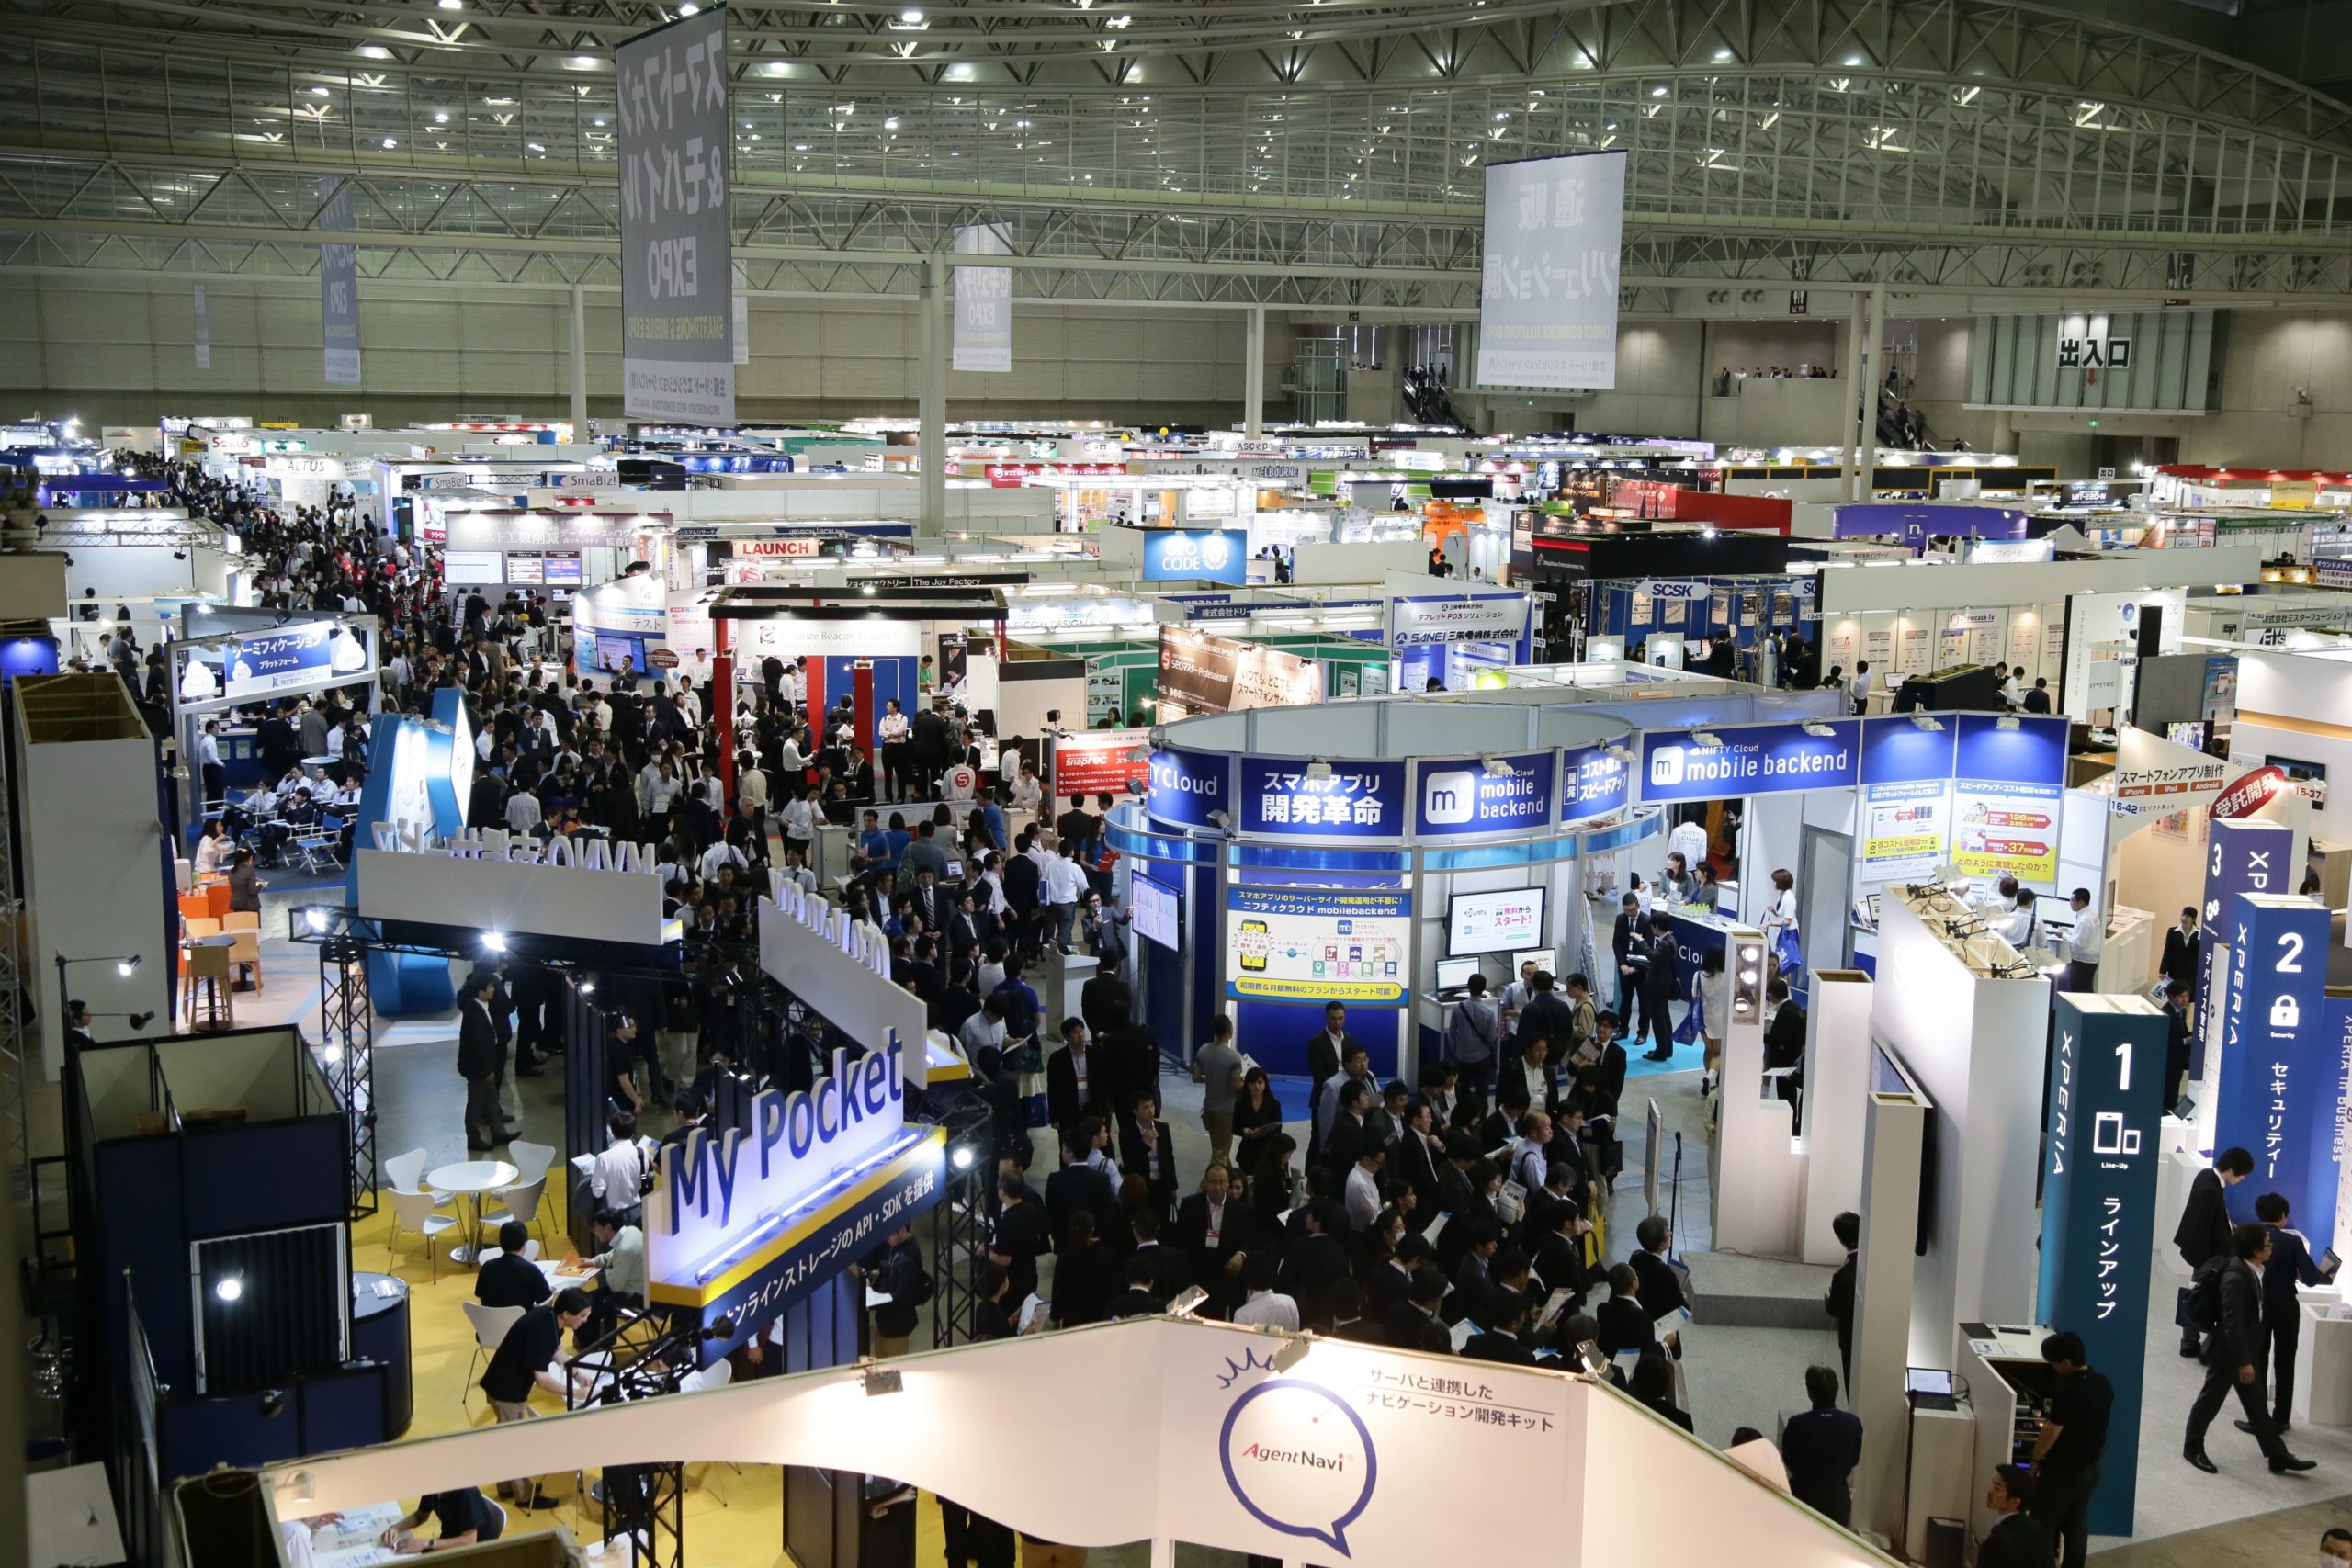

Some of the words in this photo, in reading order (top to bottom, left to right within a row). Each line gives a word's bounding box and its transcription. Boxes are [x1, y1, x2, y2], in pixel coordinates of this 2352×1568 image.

[2059, 338, 2130, 367] 出入口
[288, 460, 325, 472] ALTUS
[1251, 465, 1299, 478] MELBOURNE
[435, 477, 464, 489] SmaBiz!
[571, 476, 616, 487] SmaBiz!
[470, 529, 560, 546] テスト工数削減
[742, 543, 809, 555] LAUNCH
[1162, 558, 1200, 571] CODE
[2316, 559, 2352, 570] オウンドメディ
[914, 578, 930, 586] The
[933, 578, 947, 588] Joy
[949, 578, 981, 588] Factory
[1652, 583, 1693, 597] SCSK
[1418, 614, 1446, 622] タブレット
[1447, 612, 1463, 620] POS
[1464, 611, 1504, 620] ソリューション
[820, 631, 855, 641] Beacon
[1410, 631, 1446, 643] SANEI
[1447, 628, 1519, 642] 三栄電機株式会社
[259, 656, 299, 670] プラットフォーム
[1702, 745, 1731, 756] NIFTY
[1733, 742, 1759, 753] Cloud
[1065, 755, 1108, 768] snaprec
[1687, 753, 1758, 781] mobile
[1763, 748, 1848, 776] backend
[1162, 767, 1218, 796] Cloud
[1264, 772, 1381, 793] スマホアプリ
[2120, 763, 2225, 784] スマートフォンアプリ制作
[1480, 779, 1534, 798] mobile
[1566, 772, 1577, 798] 開発
[1579, 771, 1627, 801] スピードアップ
[2125, 788, 2146, 796] iPhone
[2165, 784, 2178, 793] iPad
[2195, 782, 2220, 790] Android
[2296, 786, 2322, 799] 15-37
[2215, 771, 2278, 819] 受託開発
[1261, 793, 1384, 826] 開発革命
[1480, 795, 1544, 819] backend
[2111, 800, 2138, 814] 16-42
[1957, 857, 2049, 871] どのように実現したのか?
[2211, 842, 2222, 877] 3
[1243, 902, 1315, 914] ニフティクラウド
[1317, 906, 1396, 916] mobilebackend
[1494, 915, 1532, 927] スタート!
[1679, 945, 1703, 964] Clo
[2276, 931, 2304, 973] 2
[2228, 922, 2248, 1045] XPERIA
[2270, 1031, 2295, 1040] Security
[2113, 1043, 2132, 1091] 1
[2052, 1028, 2074, 1176] XPERIA
[2266, 1060, 2290, 1179] セキュリティー
[662, 1128, 741, 1236] My
[752, 1026, 903, 1181] Pocket
[2332, 1095, 2347, 1163] Business
[903, 1169, 934, 1205] を提供
[2094, 1195, 2122, 1321] ラインアップ
[1368, 1367, 1493, 1401] サーバと連携した
[1366, 1392, 1555, 1433] ナビゲーション開発キット
[1242, 1442, 1344, 1472] AgentNavi
